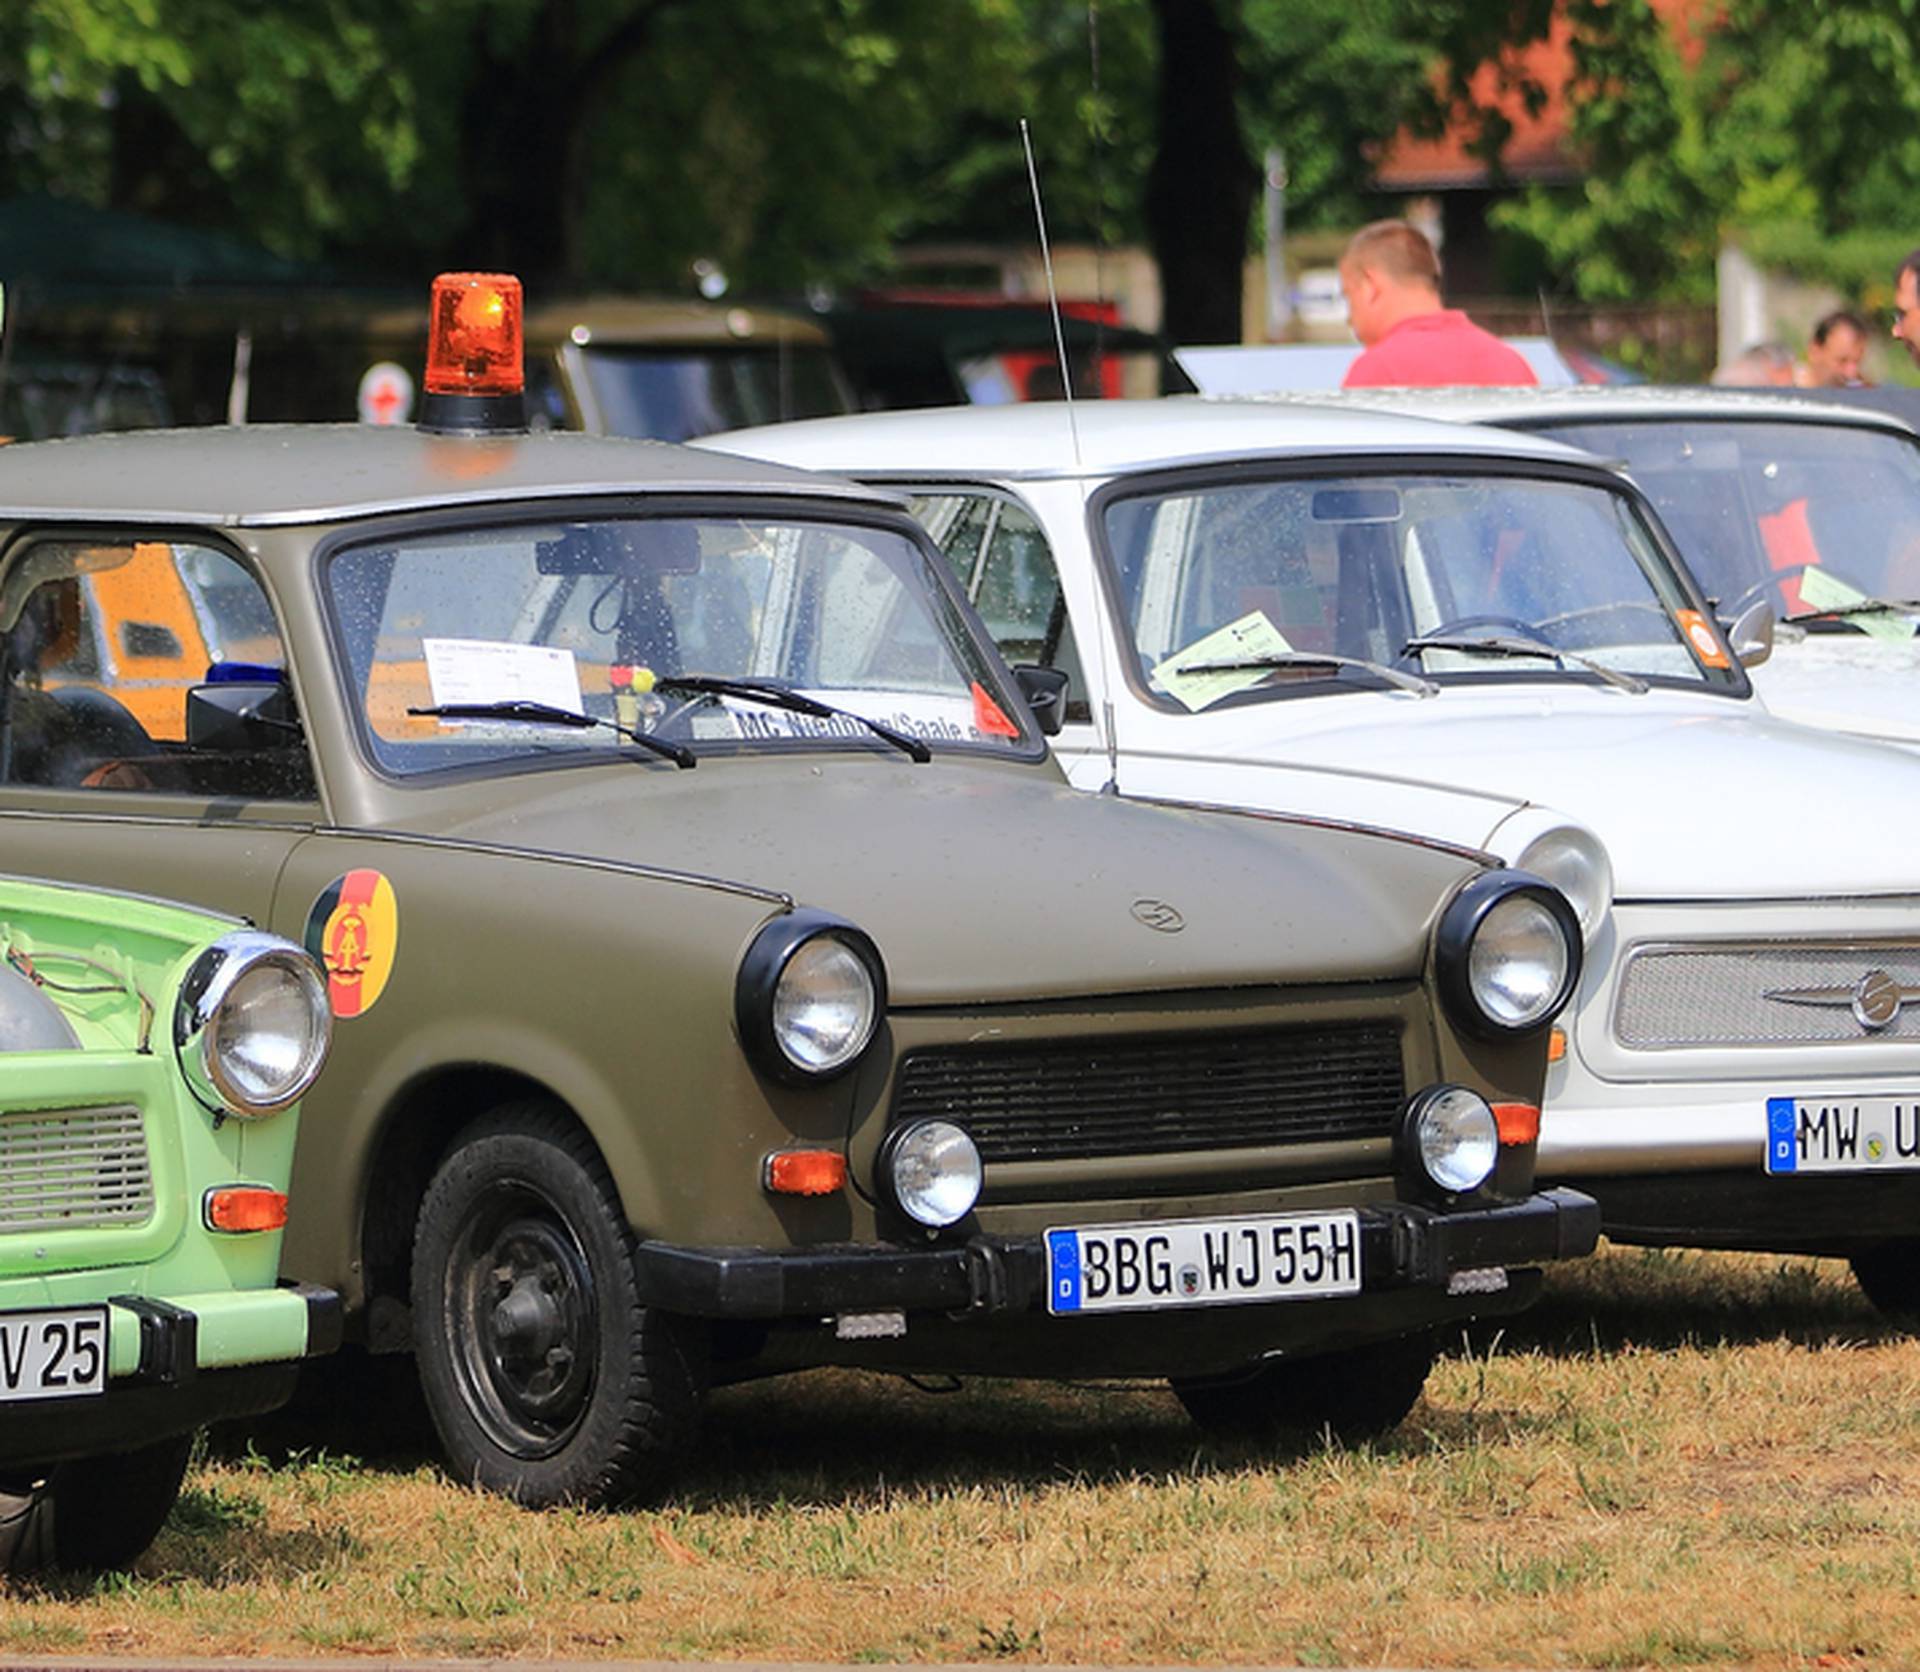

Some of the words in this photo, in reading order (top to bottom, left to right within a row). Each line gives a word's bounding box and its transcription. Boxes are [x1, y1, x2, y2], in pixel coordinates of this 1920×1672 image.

[734, 711, 780, 740] MC
[1800, 1105, 1859, 1160] MW
[1084, 1236, 1172, 1298] BBG
[1204, 1229, 1260, 1291] WJ
[1272, 1222, 1357, 1285] 55H
[0, 1325, 29, 1390] V
[41, 1321, 101, 1387] 25
